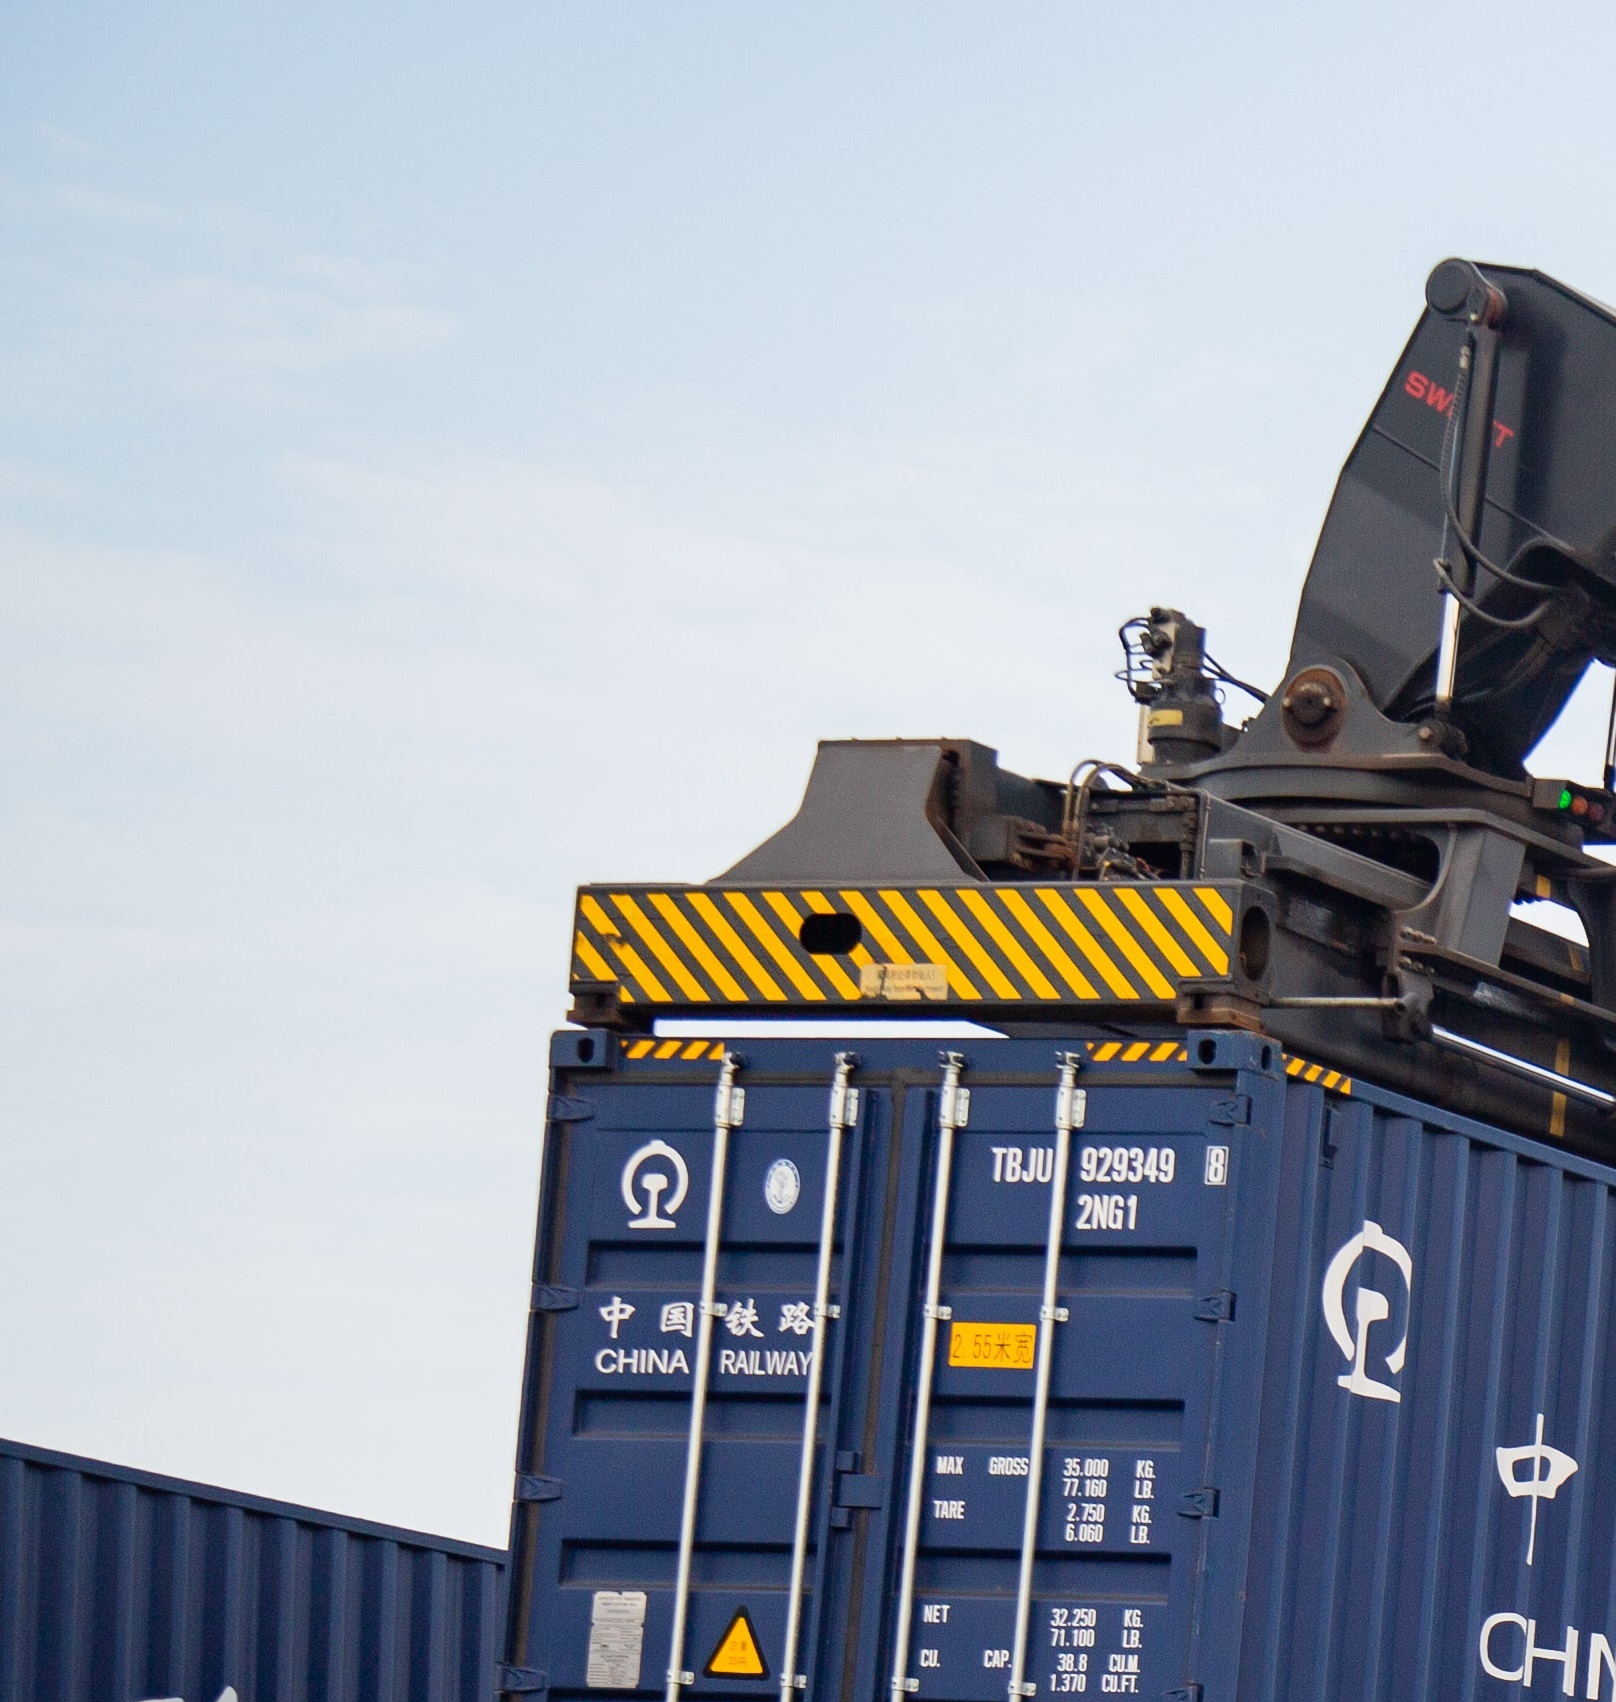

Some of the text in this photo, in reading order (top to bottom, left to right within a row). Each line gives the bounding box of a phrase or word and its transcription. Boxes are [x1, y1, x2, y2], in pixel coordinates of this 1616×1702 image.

[1404, 370, 1515, 448] SWT
[992, 1147, 1226, 1183] TBJU 929349 8
[1076, 1195, 1138, 1230] 2NG1
[599, 1296, 816, 1339] 中国铁路
[594, 1349, 814, 1376] CHINA RAILWAY
[935, 1456, 1156, 1478] MAX GROSS 35.000 KG.
[1063, 1478, 1155, 1499] 77.160 LB.
[933, 1500, 1152, 1524] TARE 2.750 KG.
[1065, 1523, 1150, 1544] 6.060 LB.
[923, 1604, 1144, 1628] NET 32.250 KG.
[1051, 1628, 1142, 1649] 71.100 LB.
[920, 1649, 940, 1668] CU.
[983, 1650, 1012, 1668] CAP.
[1057, 1653, 1088, 1672] 38.8
[1050, 1674, 1087, 1693] 1.370
